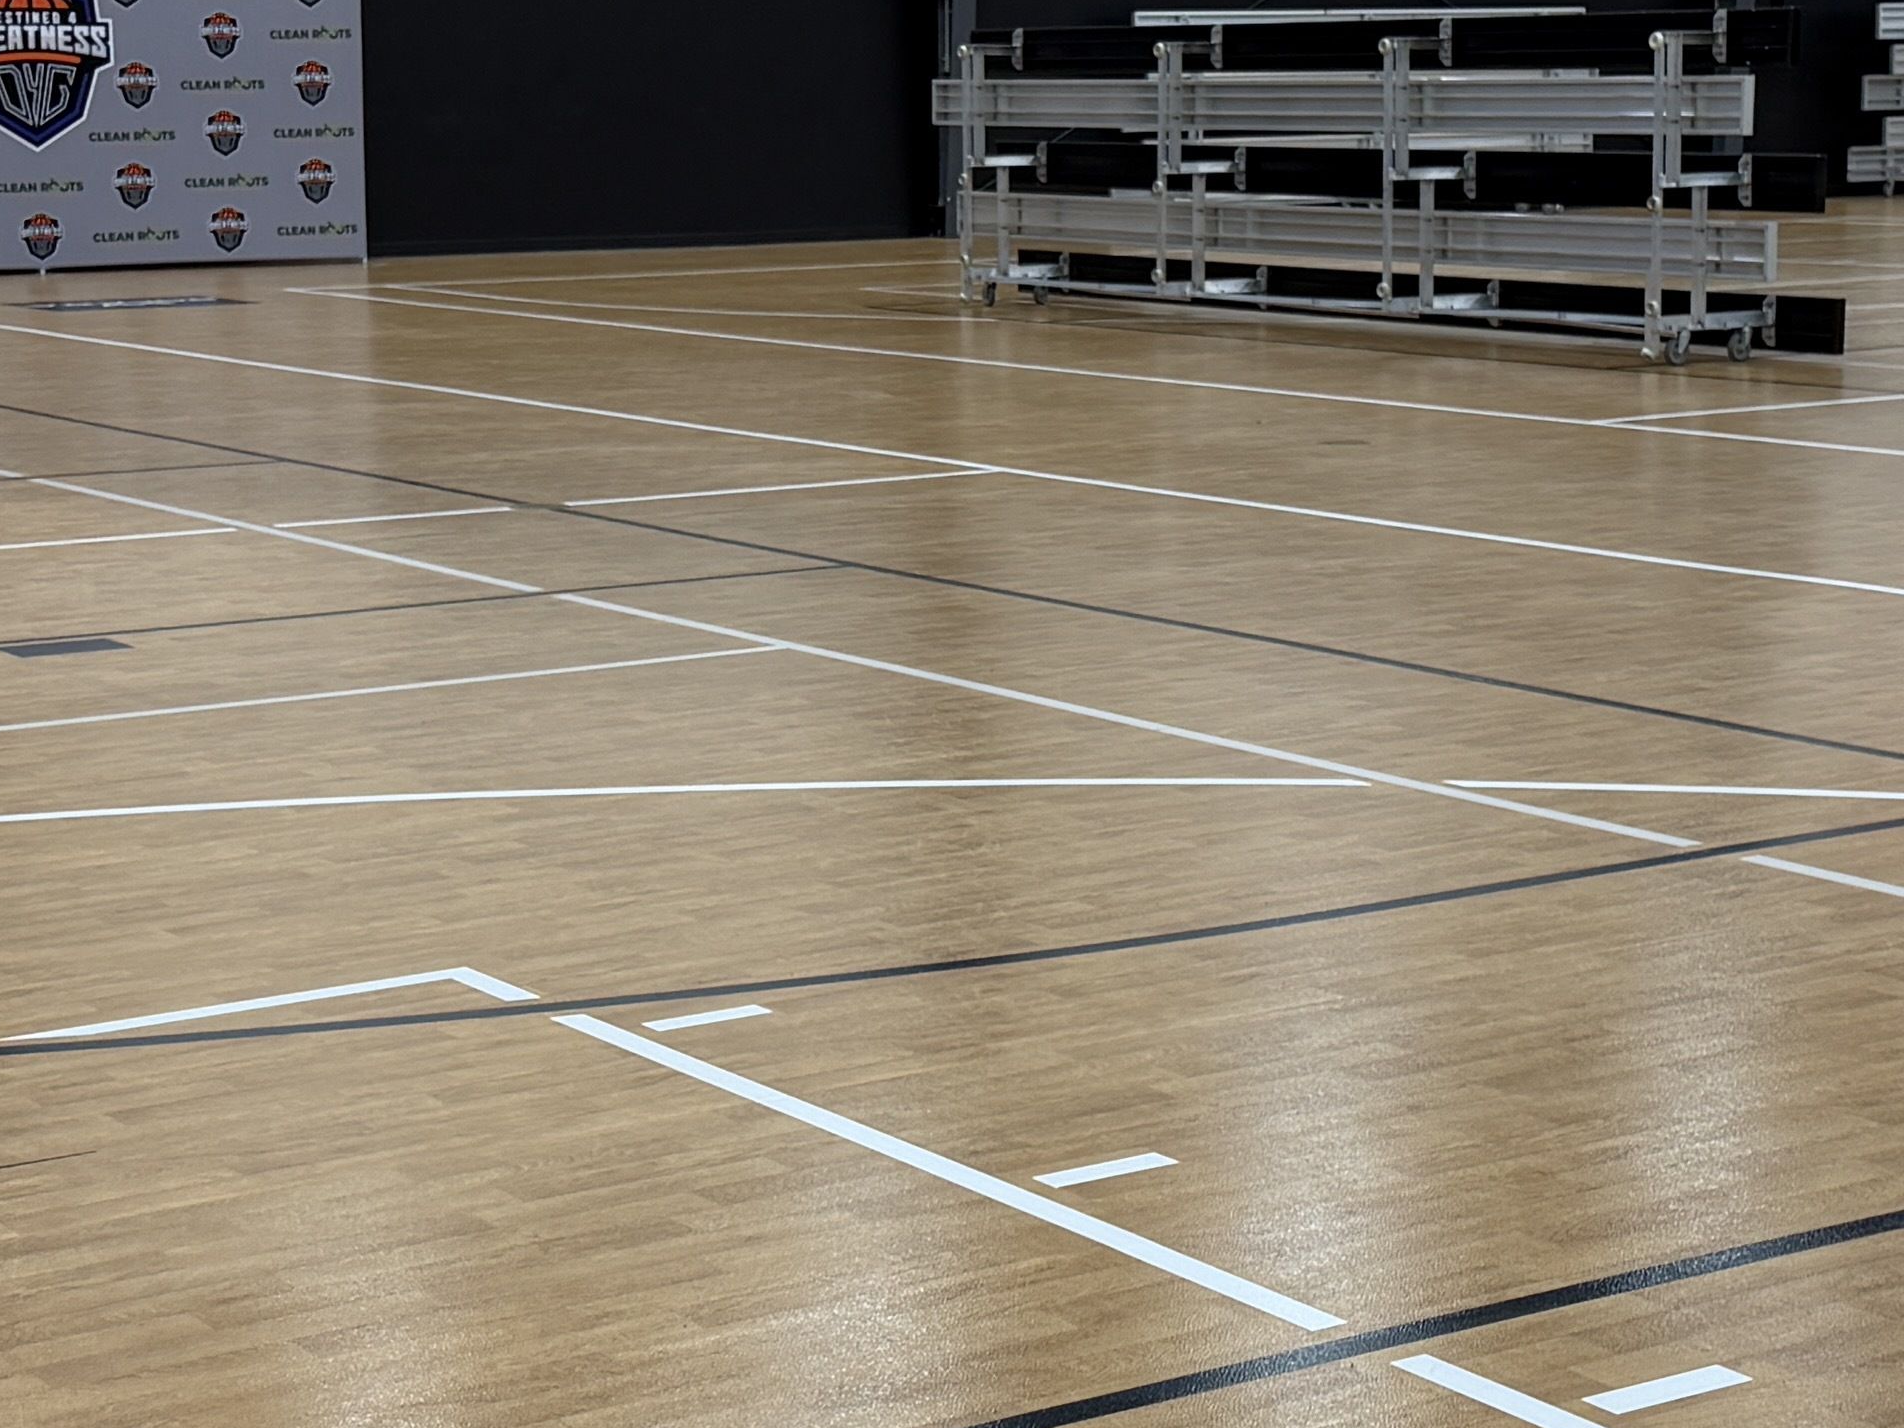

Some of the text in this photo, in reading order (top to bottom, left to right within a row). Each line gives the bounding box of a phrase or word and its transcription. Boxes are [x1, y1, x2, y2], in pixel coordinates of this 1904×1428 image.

[68, 11, 77, 24] 4
[270, 29, 309, 40] CLEAN
[180, 80, 220, 90] CLEAN
[89, 132, 130, 142] CLEAN
[274, 128, 312, 138] CLEAN
[184, 178, 224, 188] CLEAN
[277, 225, 316, 236] CLEAN
[93, 232, 134, 243] CLEAN
